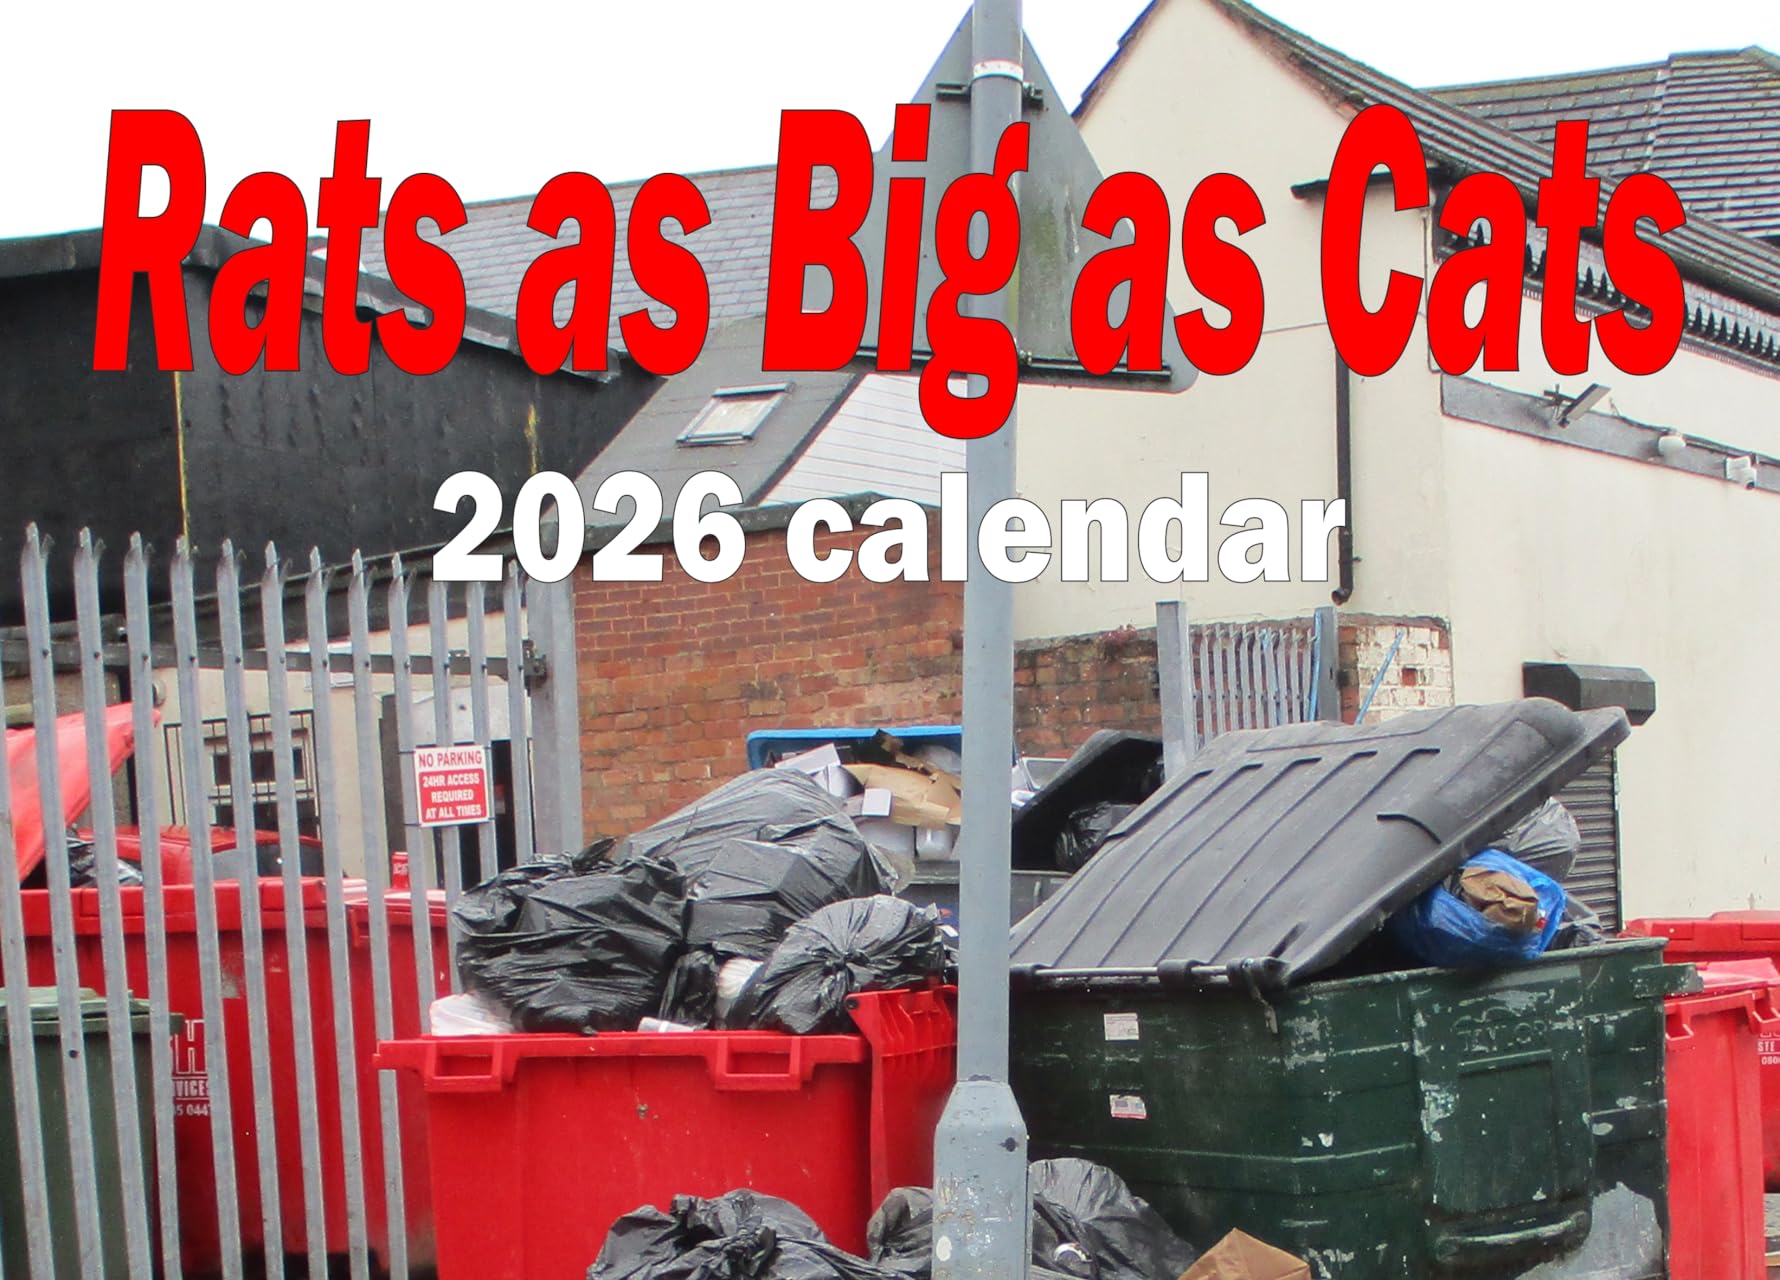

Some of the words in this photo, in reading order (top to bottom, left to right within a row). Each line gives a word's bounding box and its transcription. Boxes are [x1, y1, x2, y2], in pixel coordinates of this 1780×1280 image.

[419, 754, 434, 768] NO
[437, 751, 482, 766] PARKING
[423, 776, 446, 787] 24HR
[447, 773, 480, 785] ACCESS
[431, 789, 474, 803] REQUIRED
[426, 808, 437, 819] AT
[438, 807, 455, 818] ALL
[456, 804, 481, 816] TIMES
[1757, 1041, 1775, 1052] STE
[1761, 1056, 1780, 1065] 080
[175, 1080, 208, 1097] VICE
